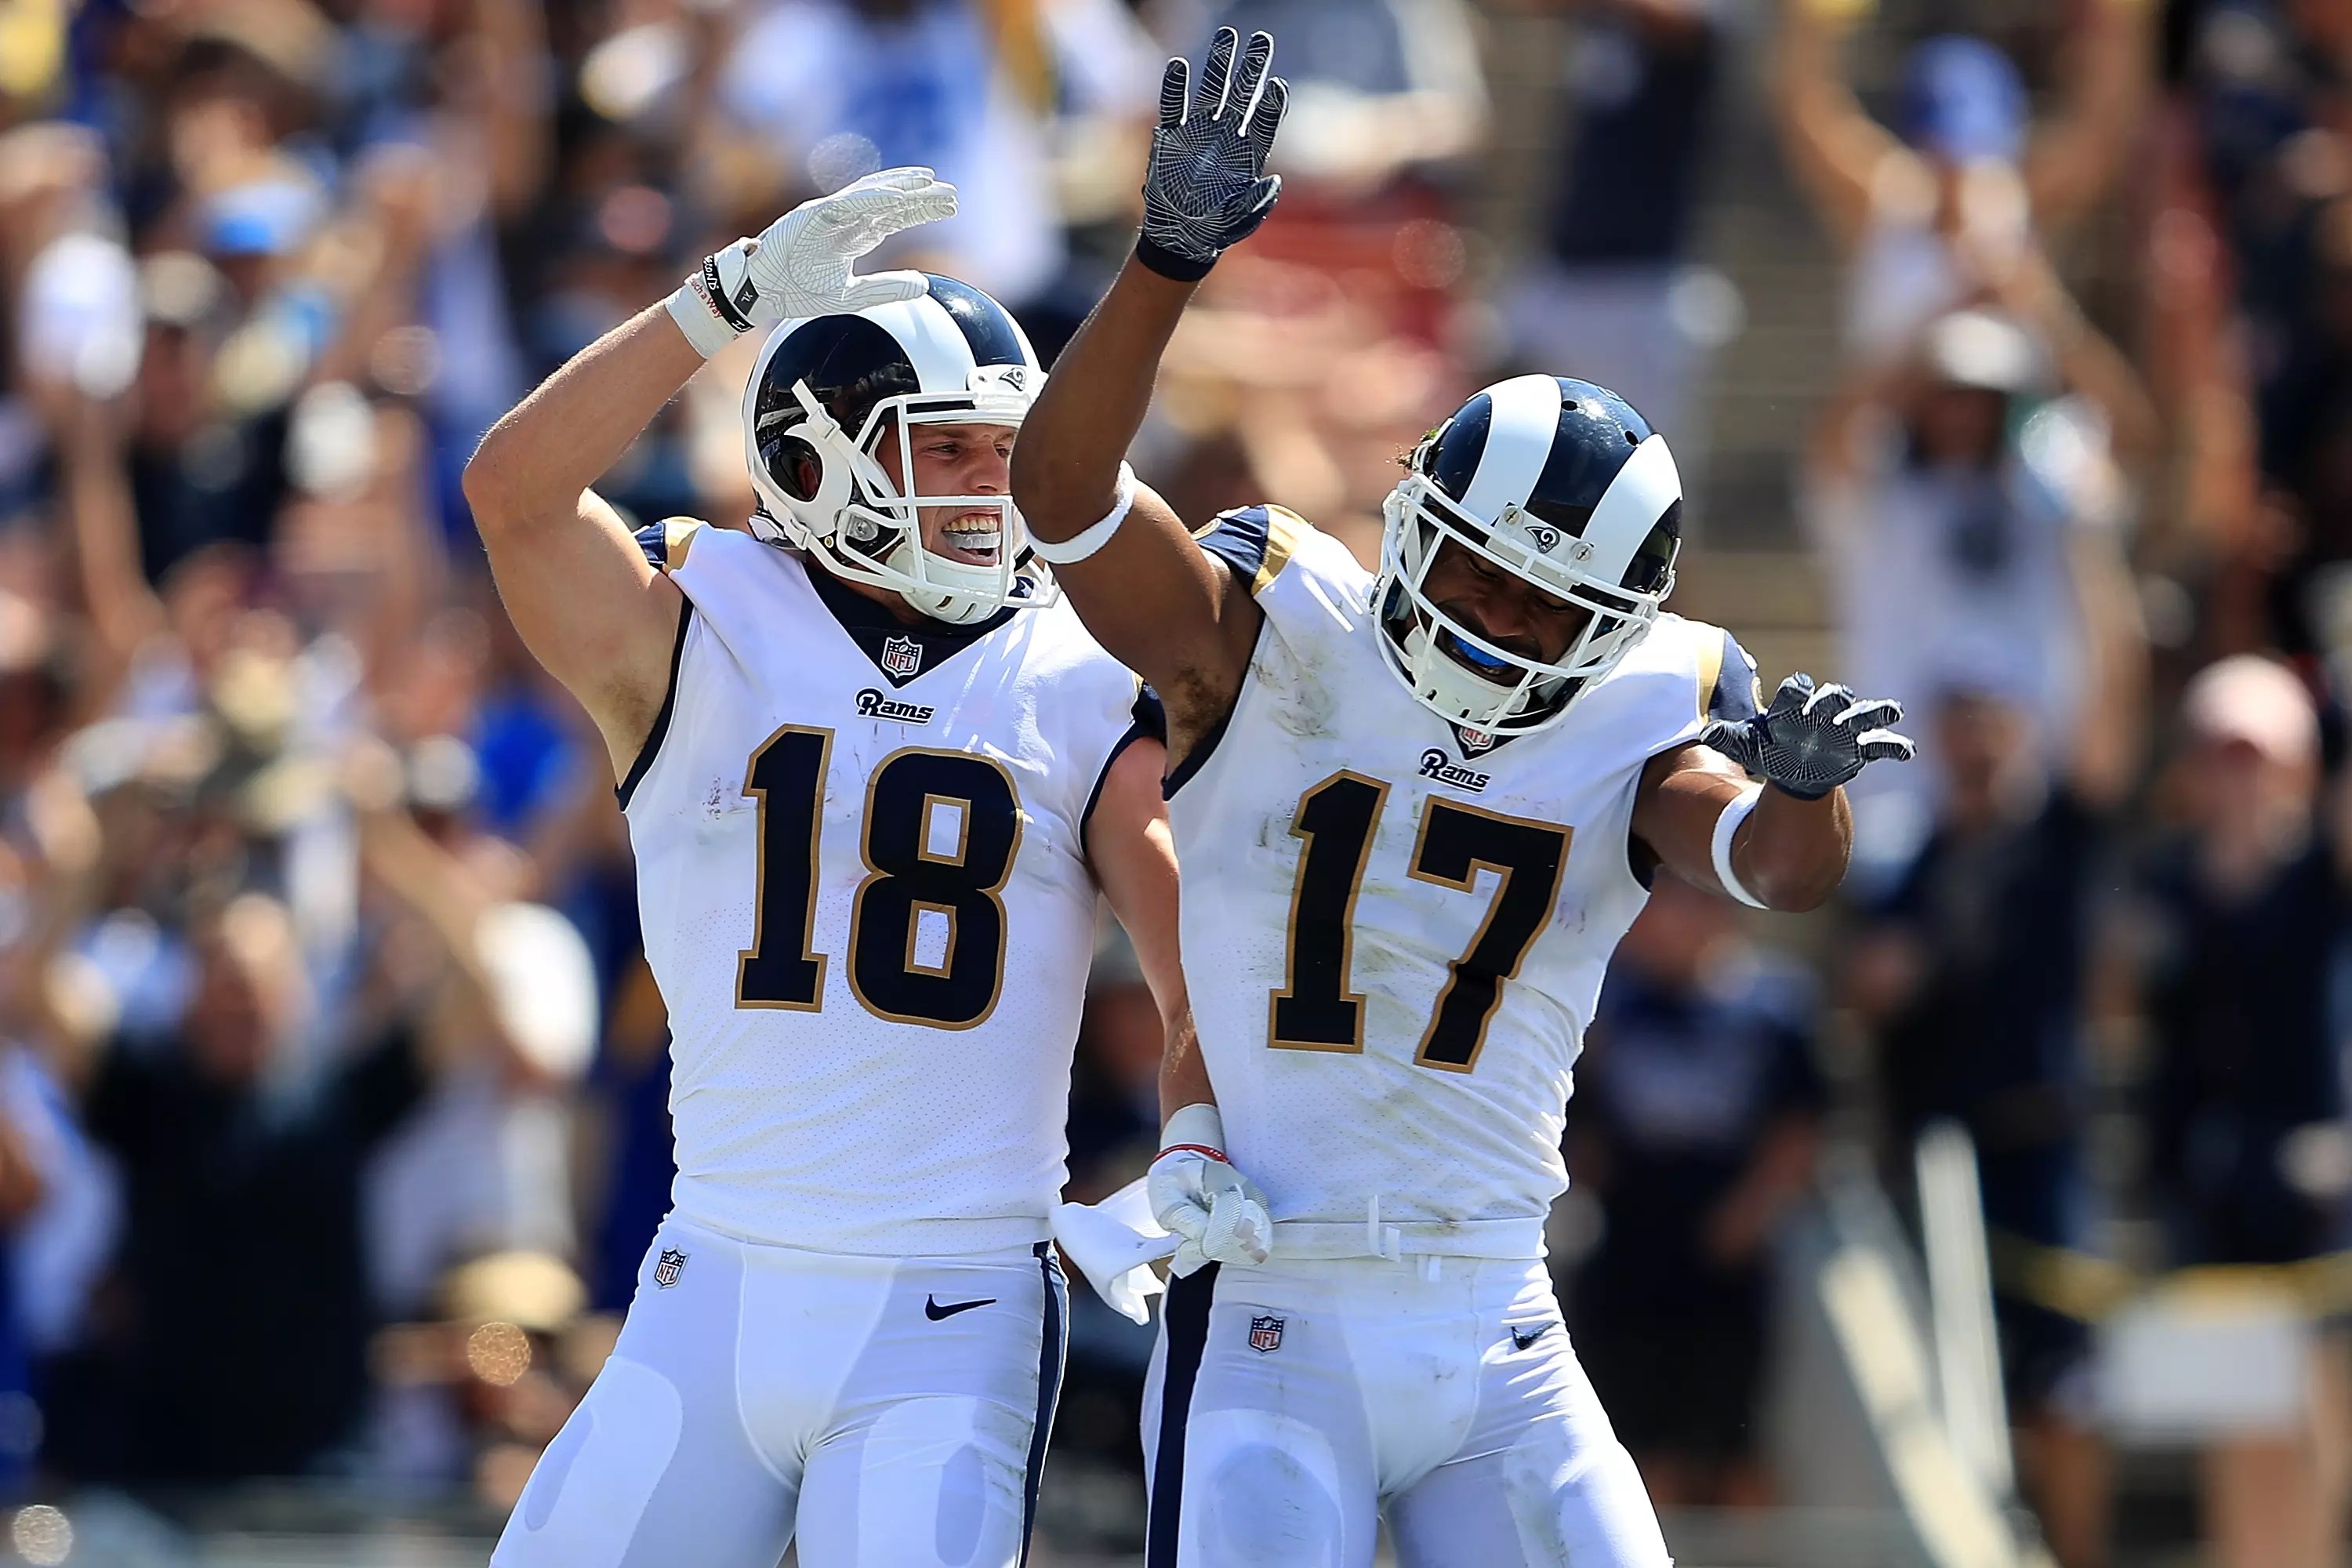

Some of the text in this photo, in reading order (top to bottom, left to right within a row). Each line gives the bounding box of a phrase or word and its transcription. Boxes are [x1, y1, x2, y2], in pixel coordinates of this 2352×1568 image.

[740, 291, 753, 303] XL
[706, 298, 722, 318] Way
[887, 652, 913, 670] NFL
[855, 688, 935, 724] Rams
[1418, 748, 1491, 793] Rams
[735, 723, 1024, 1031] 18
[1268, 768, 1574, 1074] 17
[657, 1264, 677, 1283] NFL
[1252, 1330, 1279, 1348] NFL
